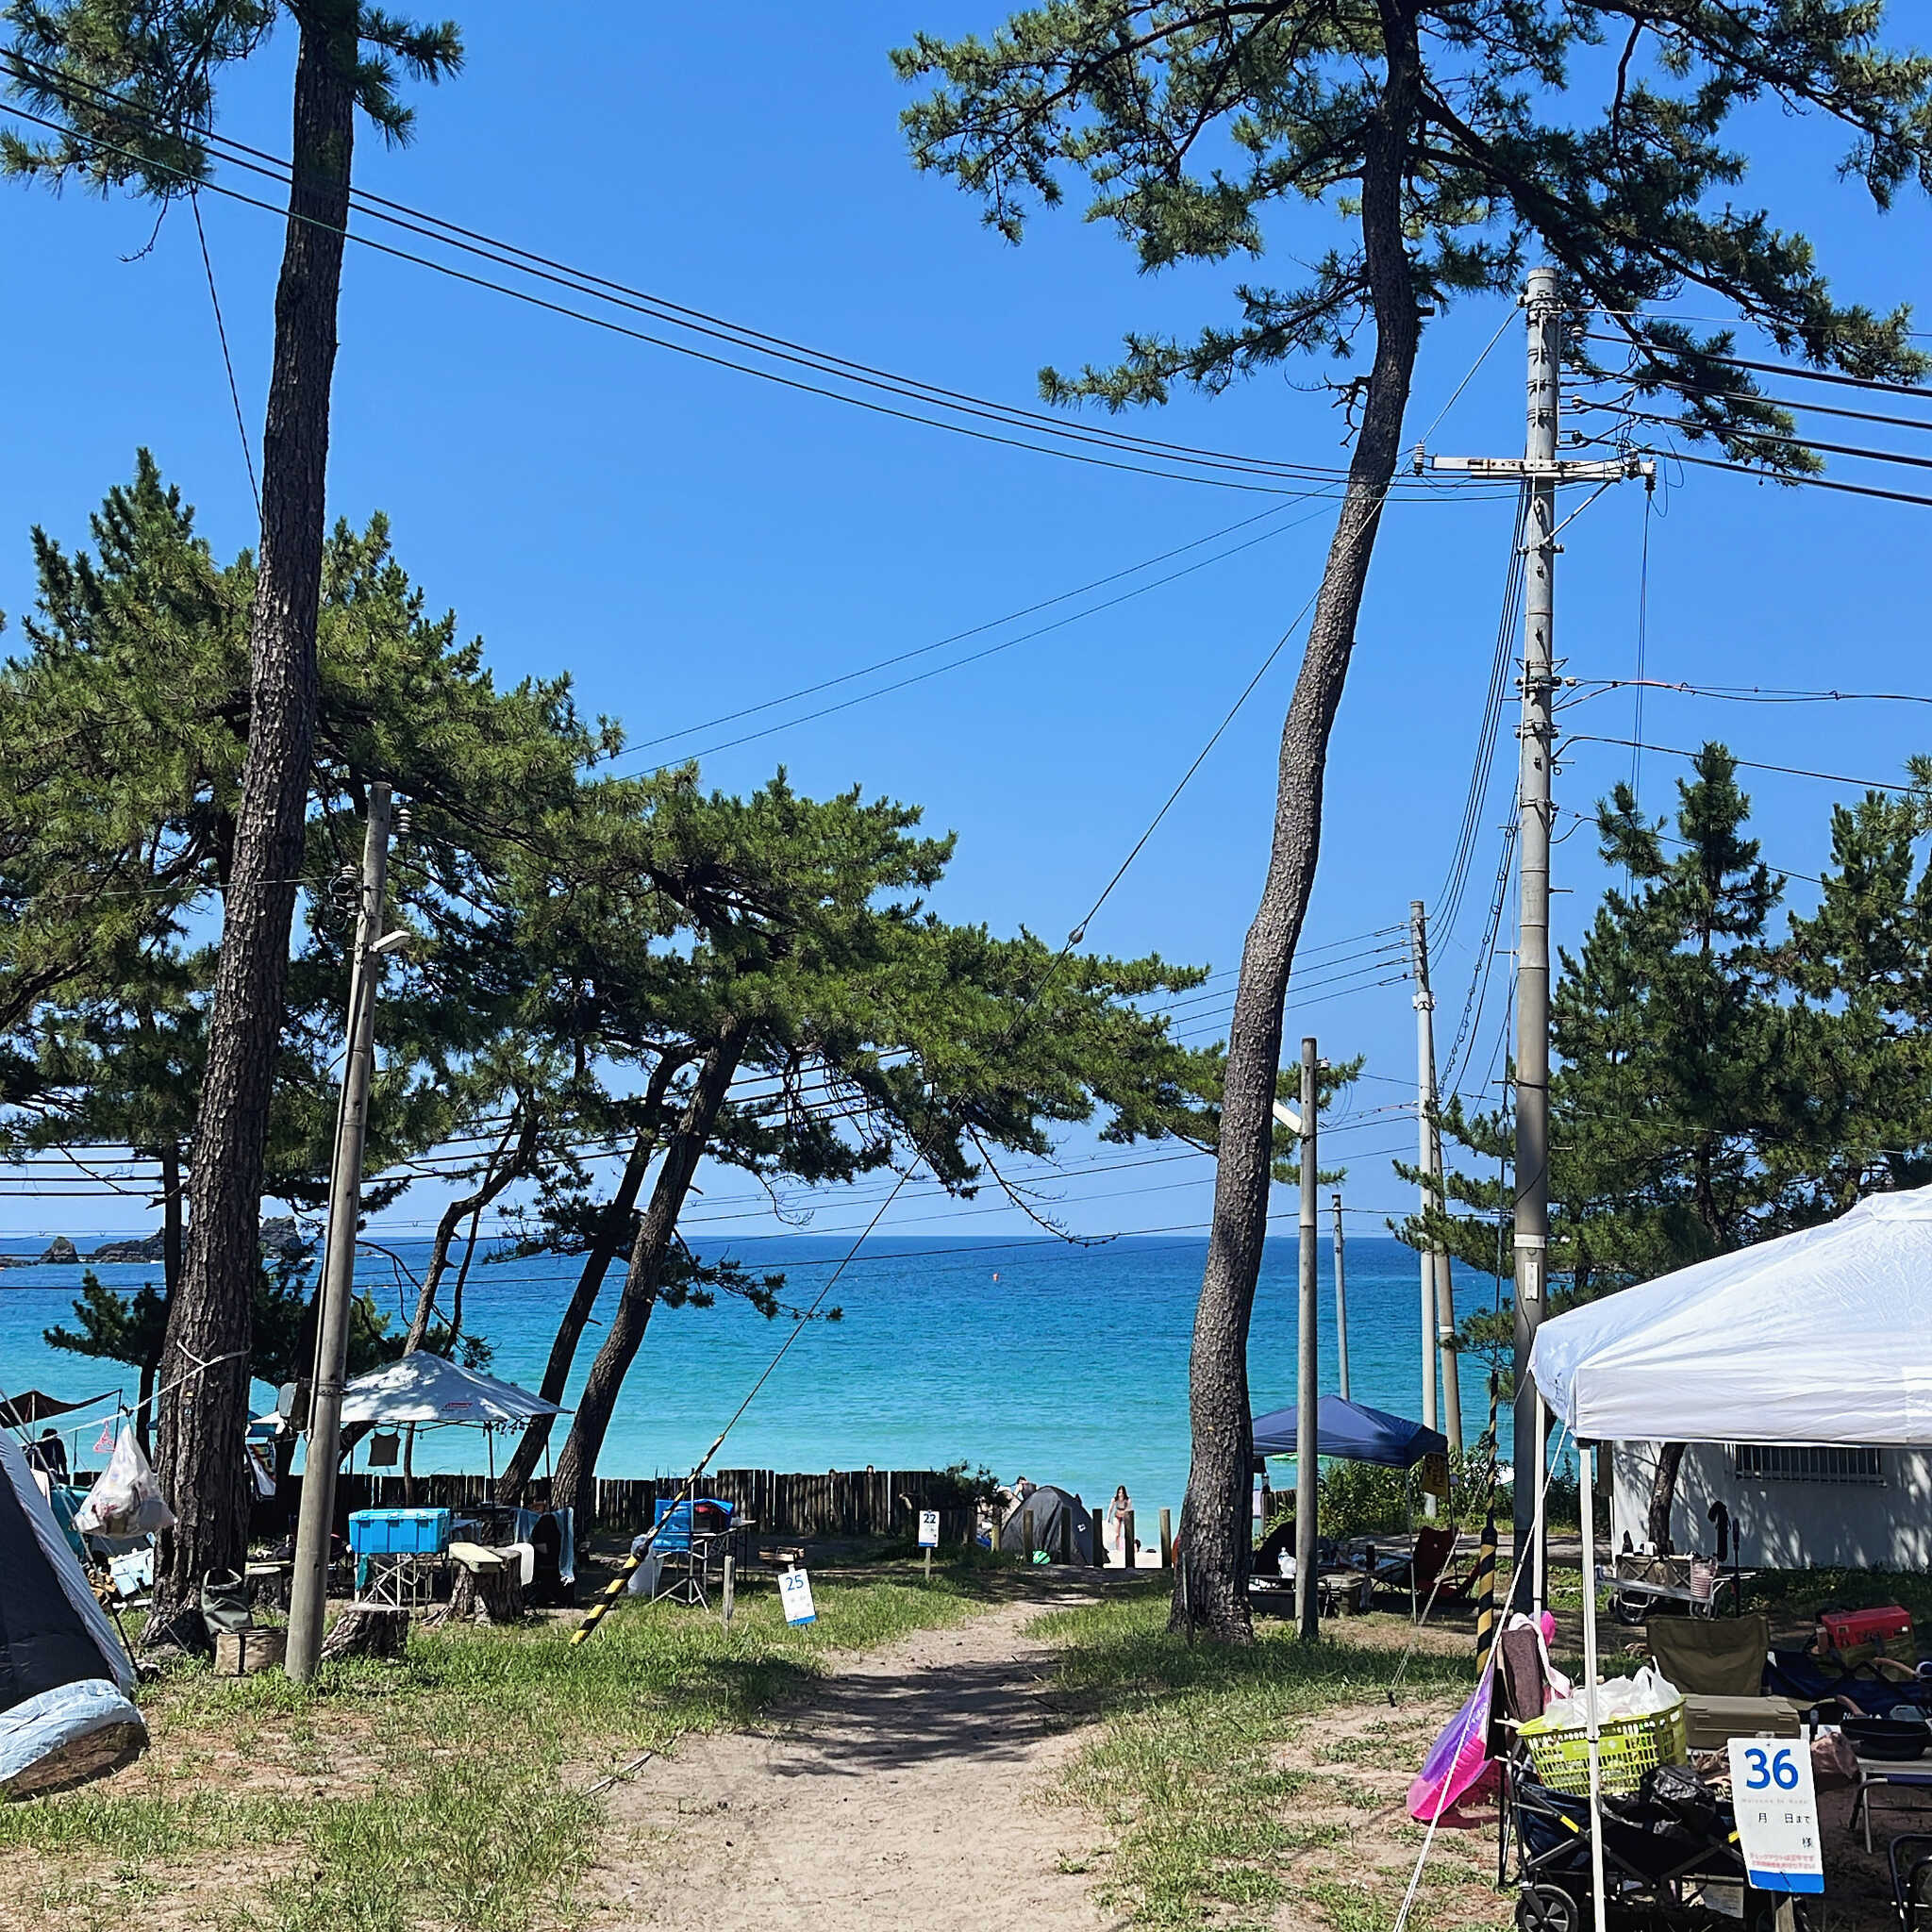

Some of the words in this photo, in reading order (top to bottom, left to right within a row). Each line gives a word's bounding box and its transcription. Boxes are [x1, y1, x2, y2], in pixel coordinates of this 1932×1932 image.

[924, 1513, 936, 1524] 22
[785, 1574, 804, 1591] 25
[1744, 1748, 1798, 1790] 36
[1758, 1812, 1767, 1824] 月
